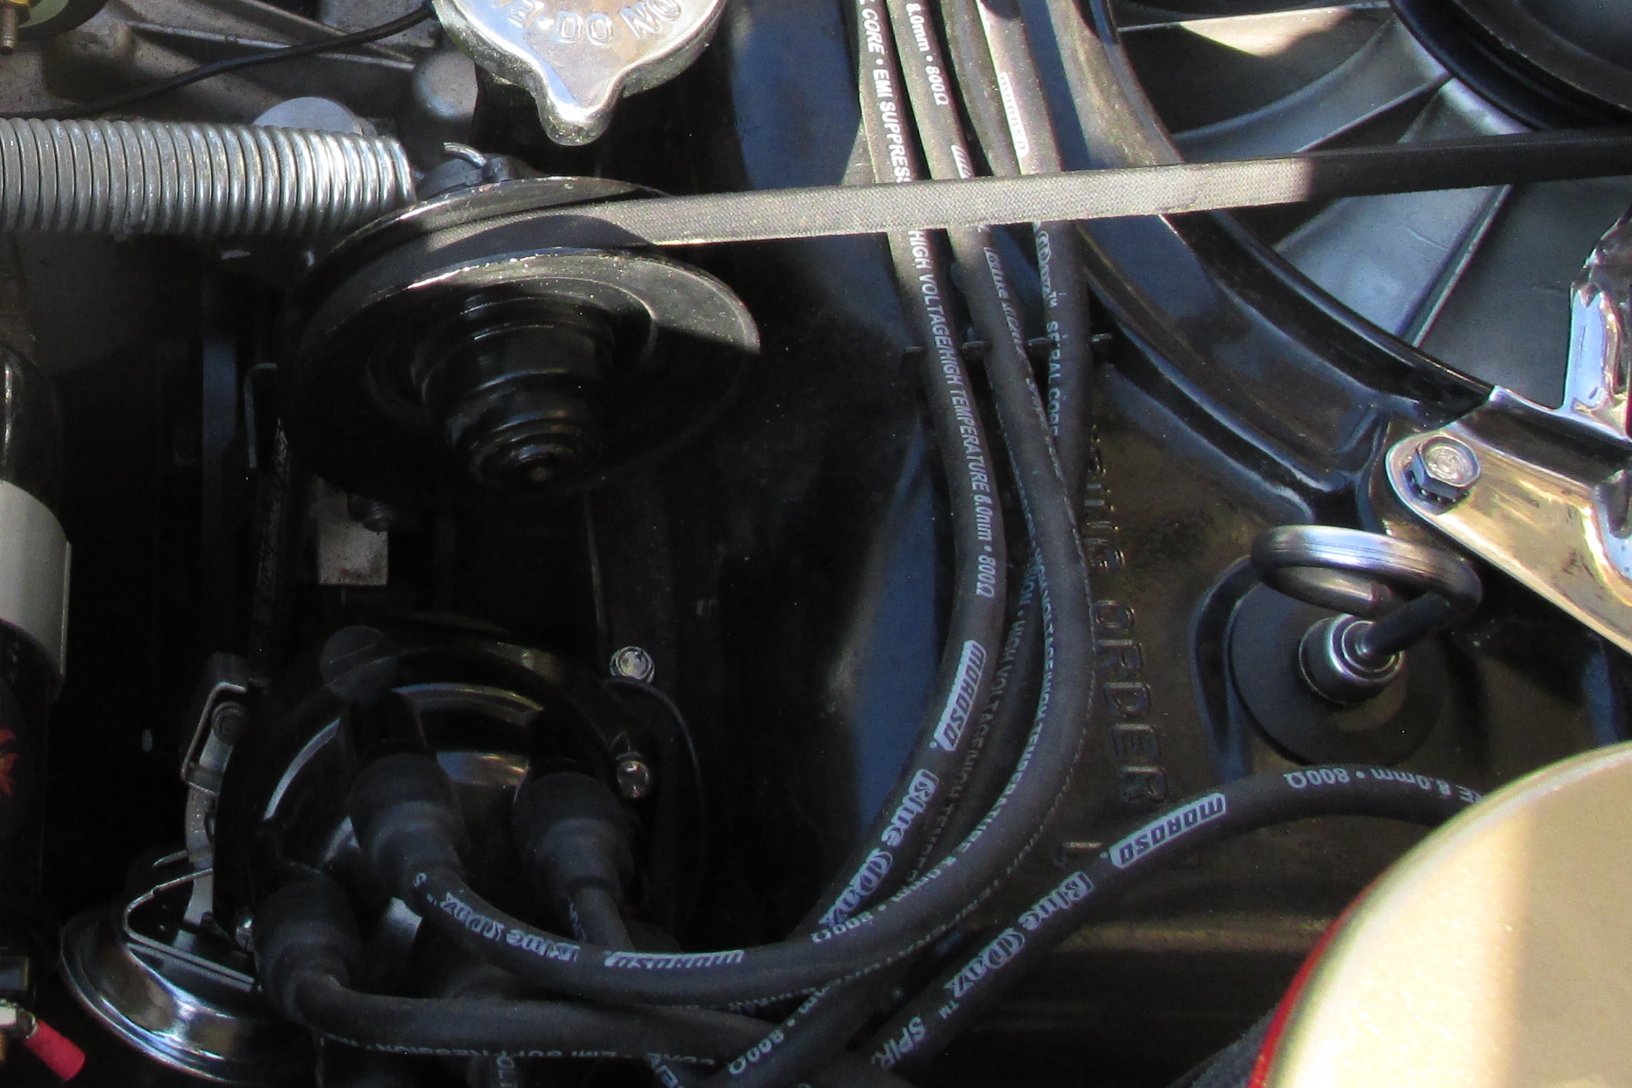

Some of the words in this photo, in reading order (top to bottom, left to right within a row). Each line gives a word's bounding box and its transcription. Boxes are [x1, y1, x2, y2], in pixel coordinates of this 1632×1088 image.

[555, 10, 615, 46] DO
[862, 9, 885, 56] CORE
[905, 1, 930, 52] 8.0mm
[924, 64, 948, 106] 800Ω
[872, 68, 893, 99] EMI
[908, 230, 929, 270] HIGH
[948, 387, 991, 493] TEMPERATURE
[975, 553, 997, 599] 800Ω
[1285, 768, 1351, 789] 800Ω
[1371, 767, 1452, 796] 8.0mm
[882, 768, 939, 847] Blue
[1017, 871, 1096, 932] Blue
